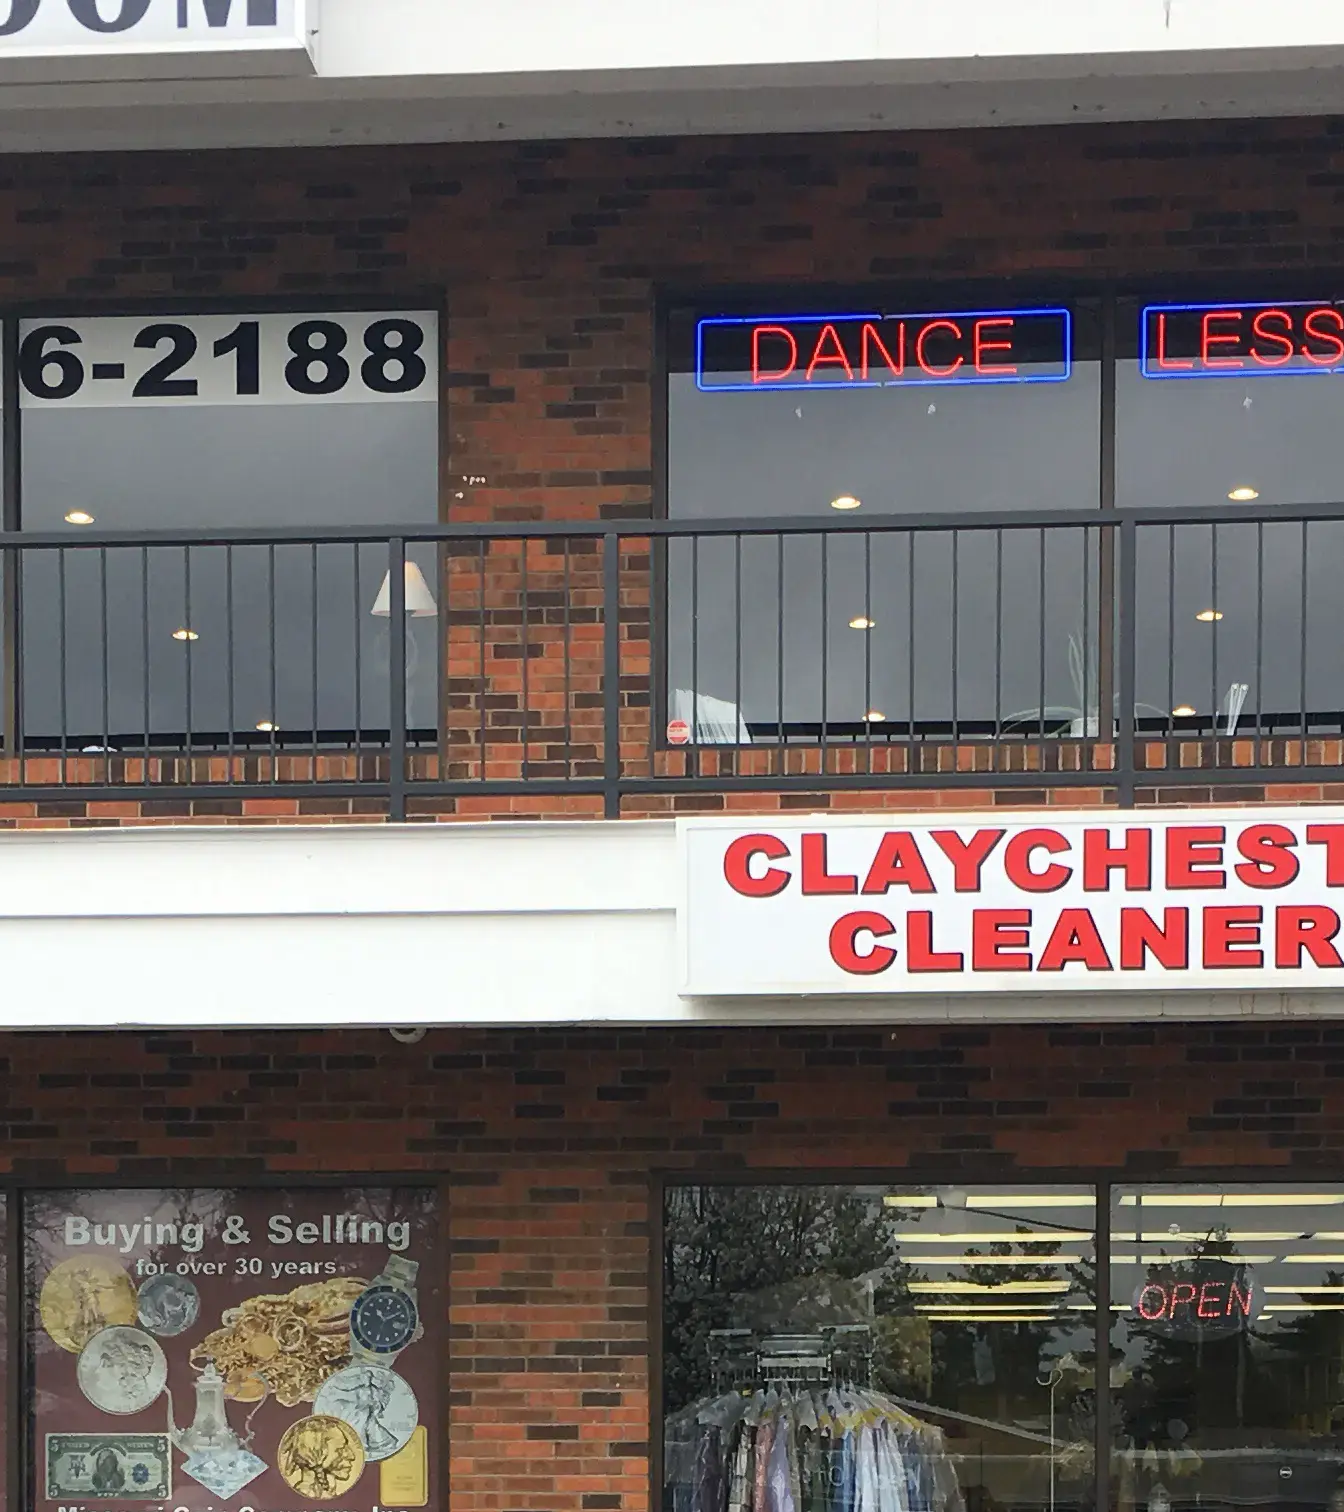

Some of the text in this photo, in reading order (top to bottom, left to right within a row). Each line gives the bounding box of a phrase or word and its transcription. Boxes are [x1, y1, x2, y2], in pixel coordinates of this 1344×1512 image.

[752, 319, 1017, 383] DANCE
[64, 1214, 410, 1253] Buying & Selling
[136, 1258, 337, 1279] for over 30 years
[1138, 1281, 1254, 1320] OPEN
